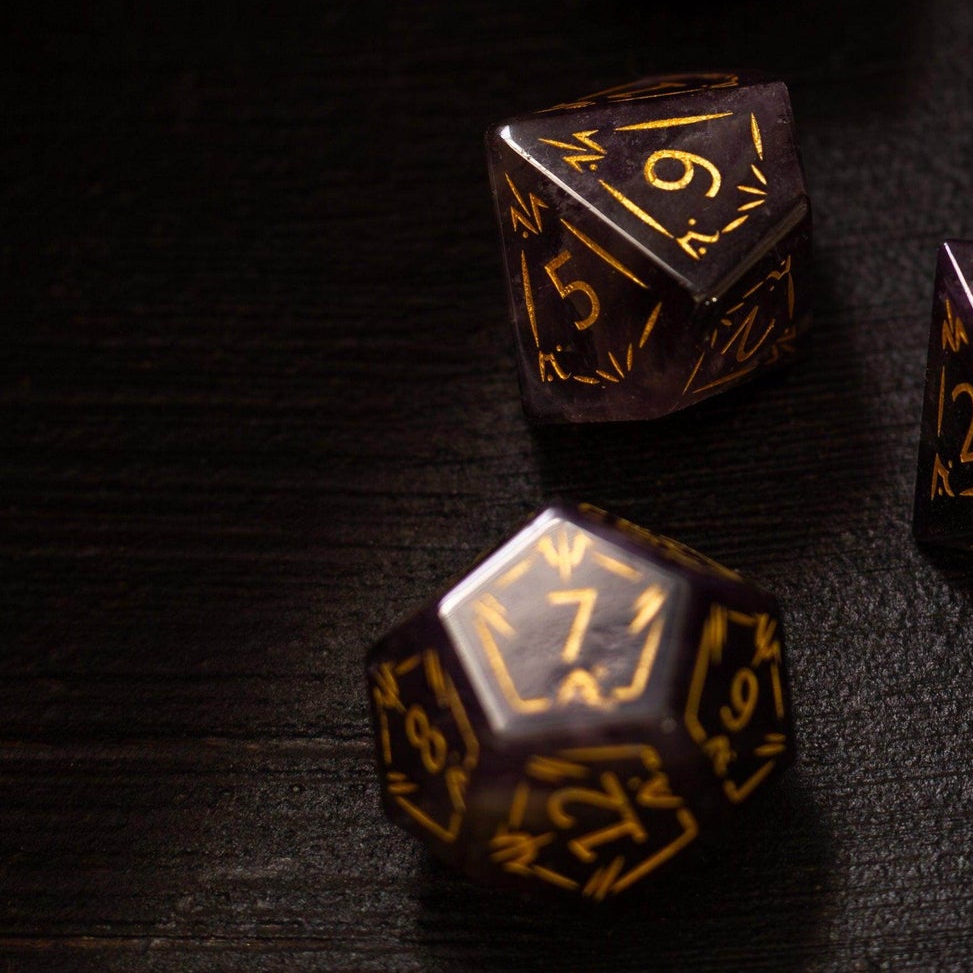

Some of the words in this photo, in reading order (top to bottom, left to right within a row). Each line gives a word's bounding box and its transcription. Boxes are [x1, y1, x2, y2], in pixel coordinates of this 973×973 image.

[644, 149, 722, 198] 9
[544, 249, 601, 331] 5
[548, 588, 598, 663] 7
[405, 703, 447, 774] 8
[547, 771, 649, 864] 12
